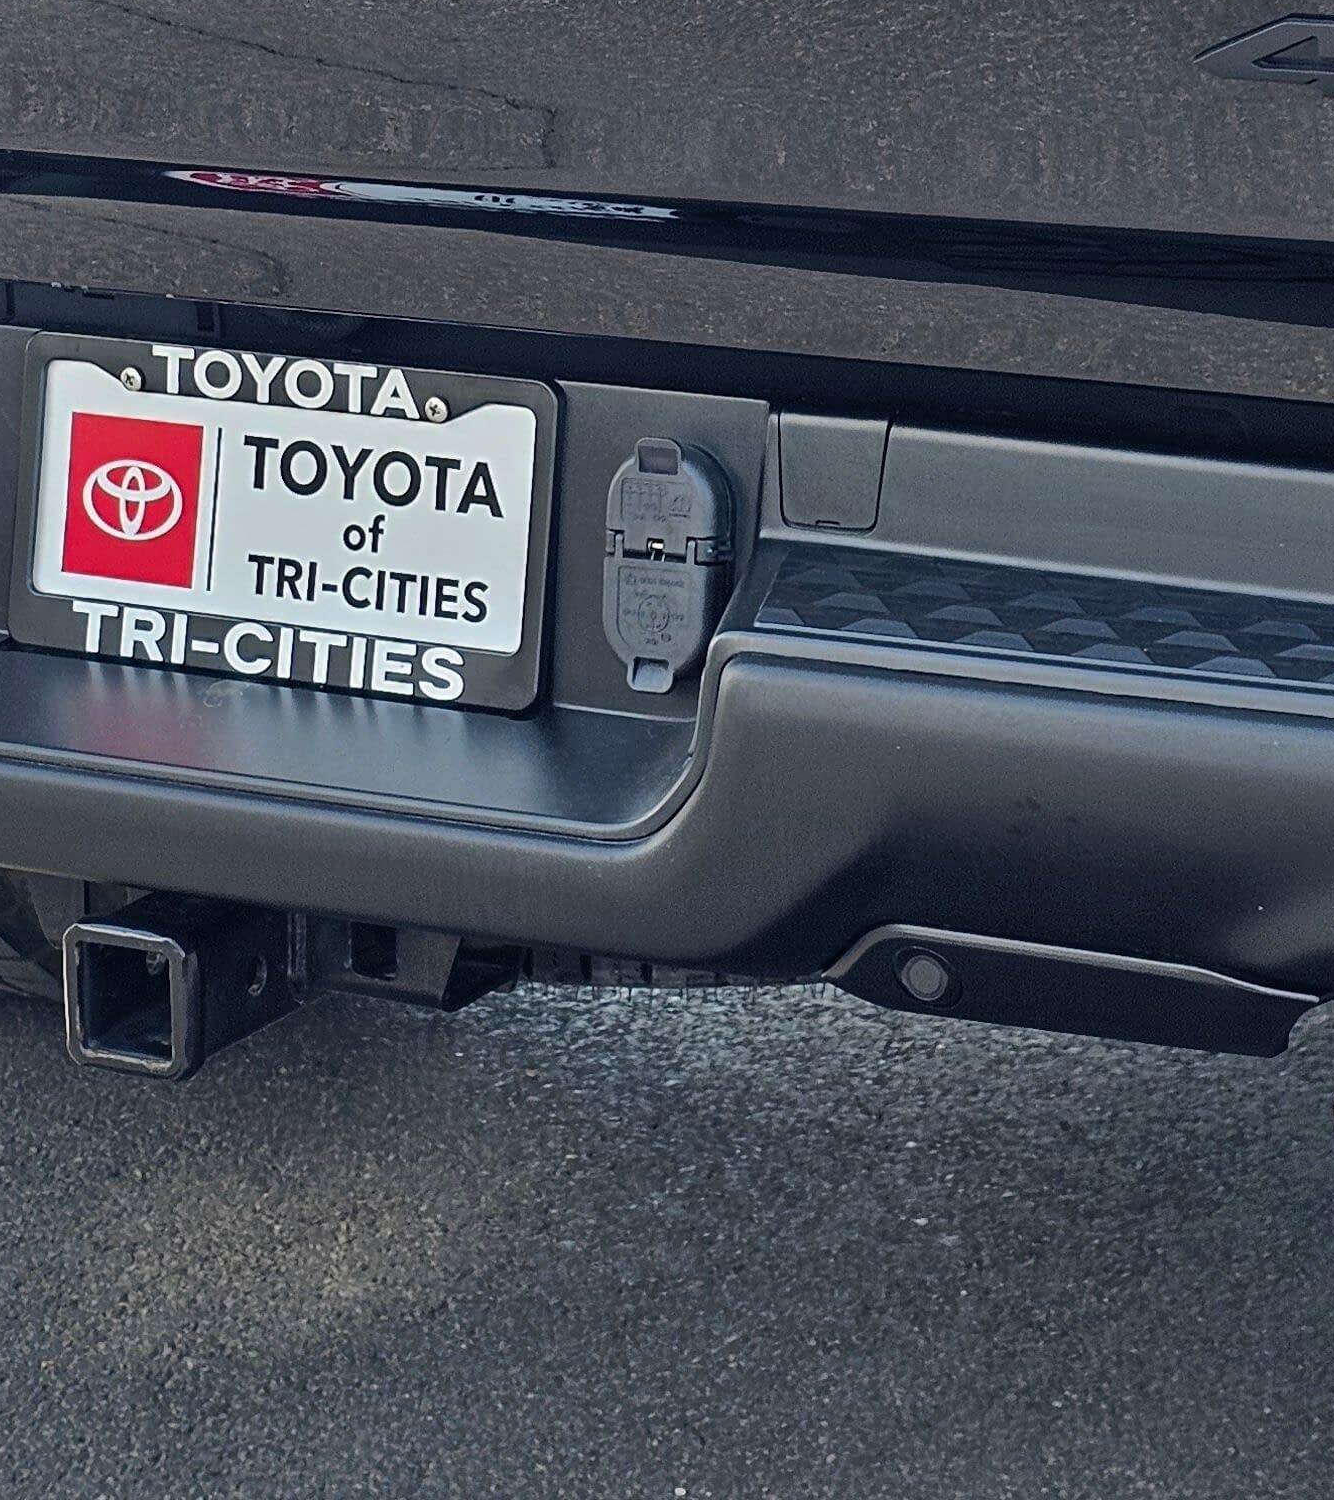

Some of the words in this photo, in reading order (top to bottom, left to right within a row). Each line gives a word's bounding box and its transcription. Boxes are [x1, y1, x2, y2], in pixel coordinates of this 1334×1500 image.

[152, 344, 420, 421] TOYOTA
[243, 434, 505, 519] TOYOTA
[342, 513, 386, 554] of
[247, 553, 489, 624] TRI-CITIES
[71, 600, 466, 702] TRI-CITIES
